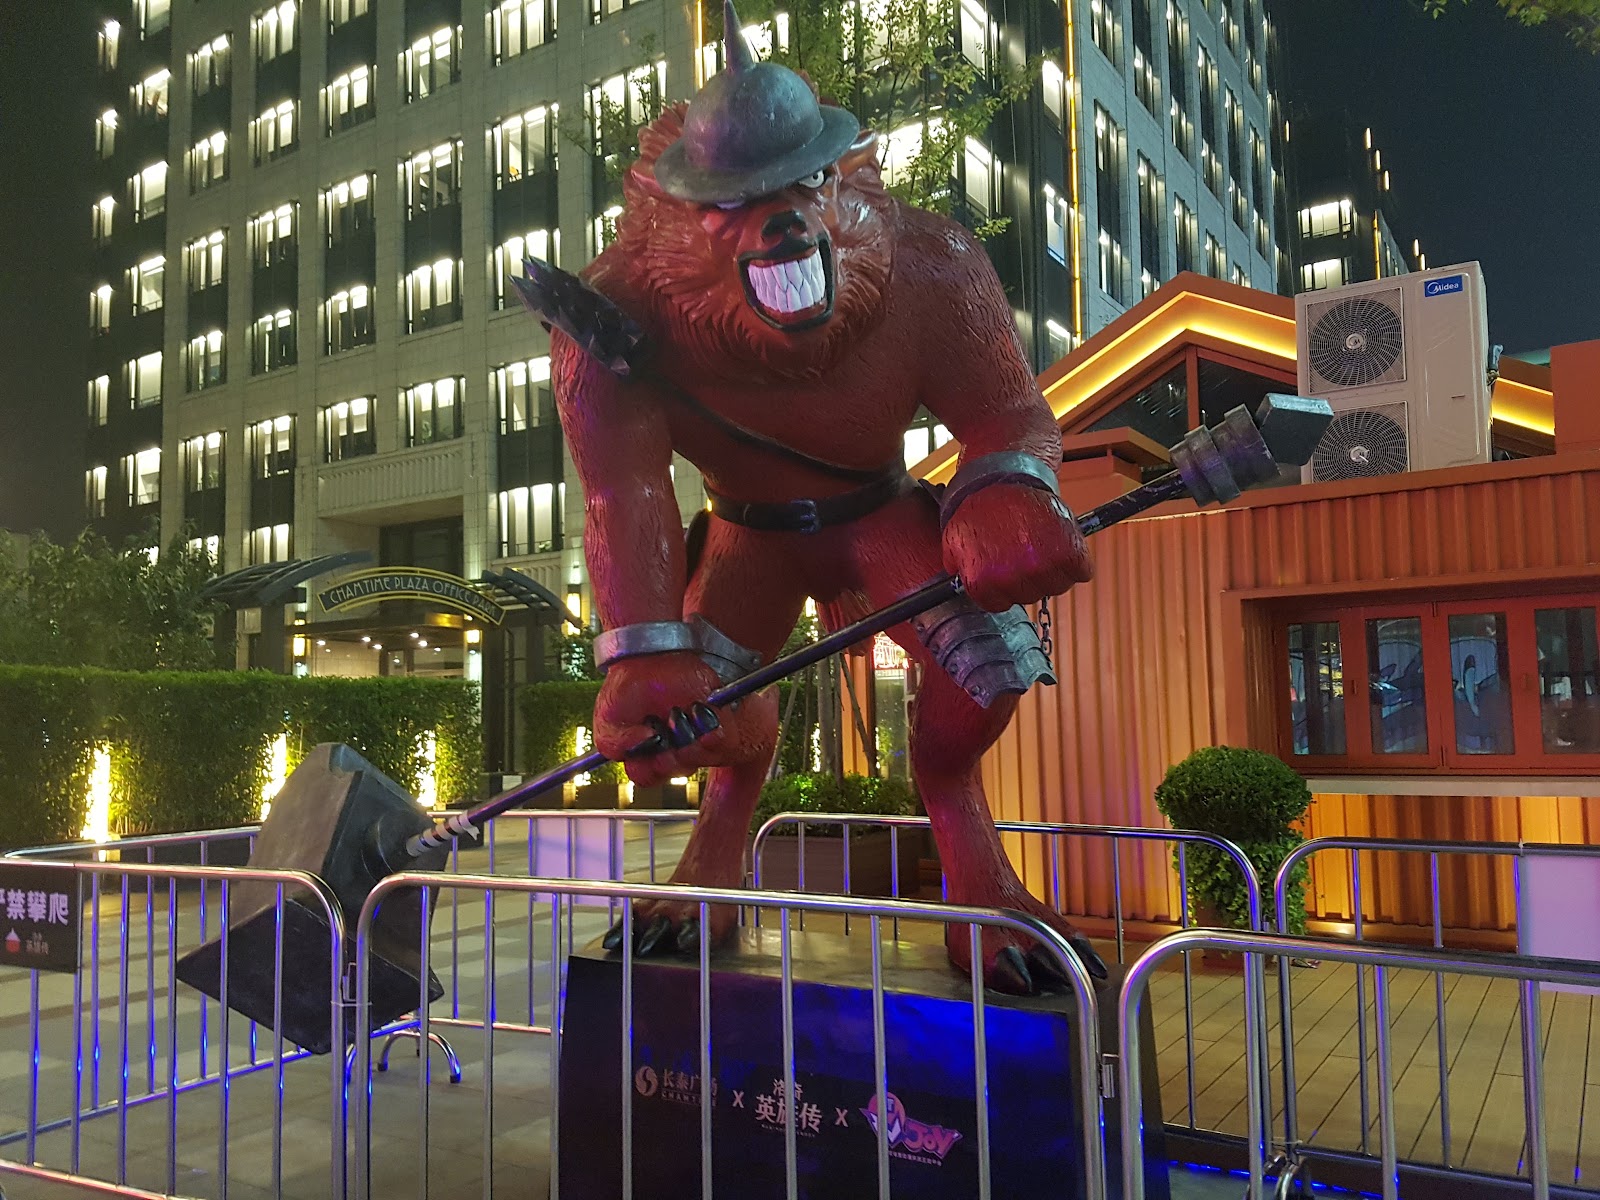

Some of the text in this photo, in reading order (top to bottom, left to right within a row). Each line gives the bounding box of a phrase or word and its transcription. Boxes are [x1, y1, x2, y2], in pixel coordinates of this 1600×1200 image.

[1430, 282, 1459, 293] Midea
[329, 576, 497, 617] CHAMTIME PLAZA OFFICE PARK
[0, 887, 69, 926] 禁攀爬
